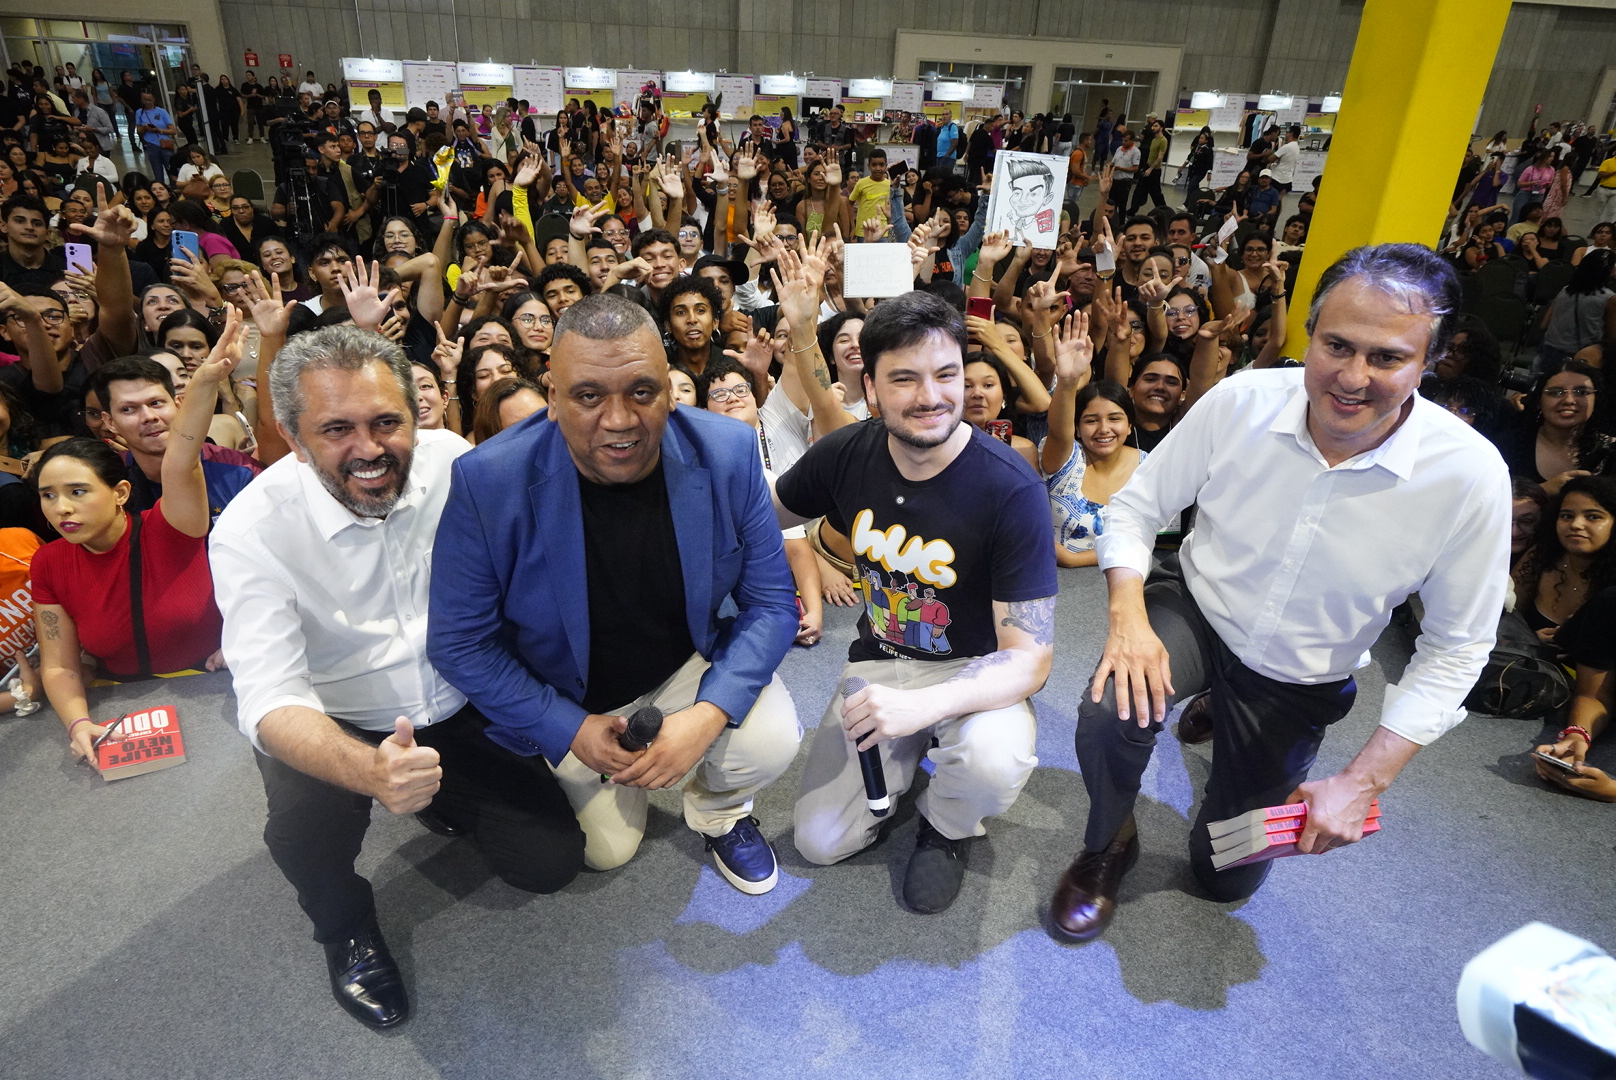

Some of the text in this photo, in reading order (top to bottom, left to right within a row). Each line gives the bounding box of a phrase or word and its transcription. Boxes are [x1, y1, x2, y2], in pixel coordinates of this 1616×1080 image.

[879, 643, 899, 658] FELIPE
[122, 735, 172, 752] NETO
[108, 745, 175, 766] FELIPE
[1270, 805, 1303, 816] FELIPE NETO
[1268, 822, 1283, 831] NETO
[1272, 834, 1286, 842] NETO
